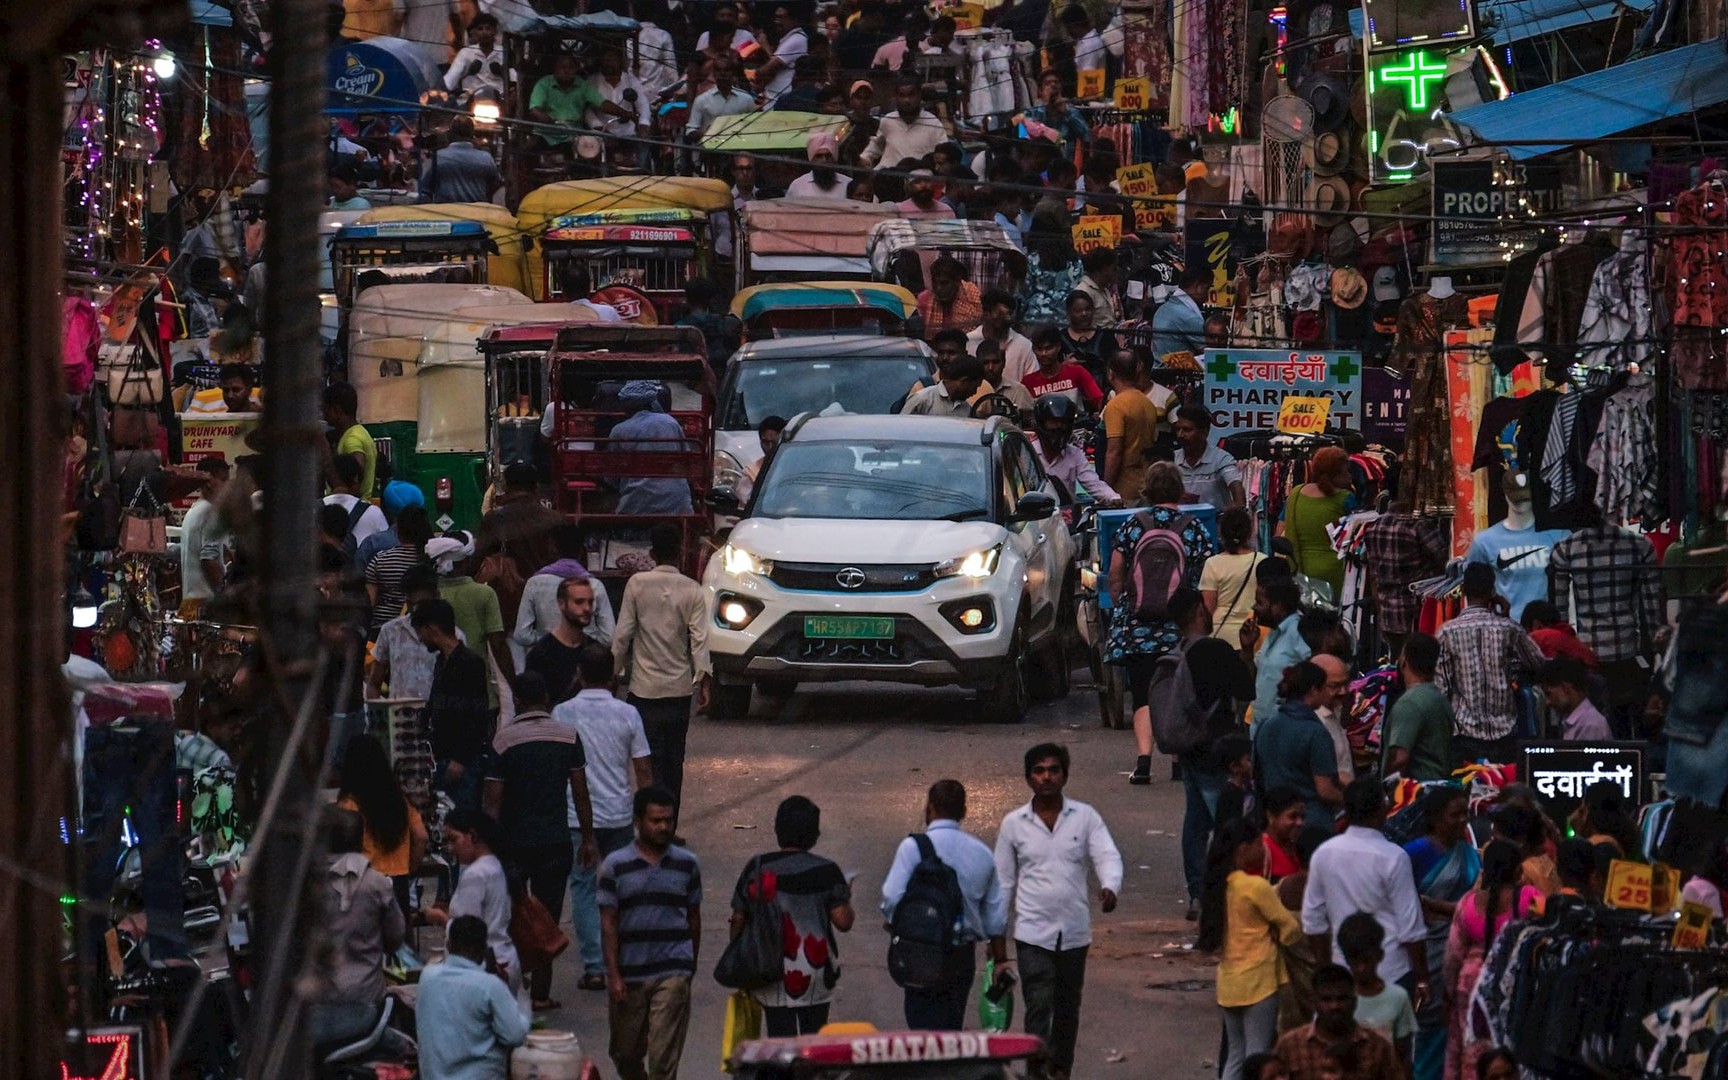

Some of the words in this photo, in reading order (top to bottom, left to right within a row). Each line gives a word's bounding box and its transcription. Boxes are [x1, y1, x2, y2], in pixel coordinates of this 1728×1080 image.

[335, 73, 375, 90] Cream
[1120, 95, 1142, 108] 200
[1126, 169, 1144, 180] SALE
[630, 230, 678, 241] 9211696901
[1082, 229, 1101, 239] SALE
[1238, 352, 1326, 385] दवाईयाँ
[1033, 379, 1074, 396] WARRIOR
[1292, 403, 1315, 413] SALE
[1281, 414, 1322, 429] 100/-
[184, 425, 240, 437] DRUNKYARD
[190, 439, 213, 449] CAFE
[1499, 544, 1549, 570] NIKE
[851, 1034, 989, 1064] SHATABDI
